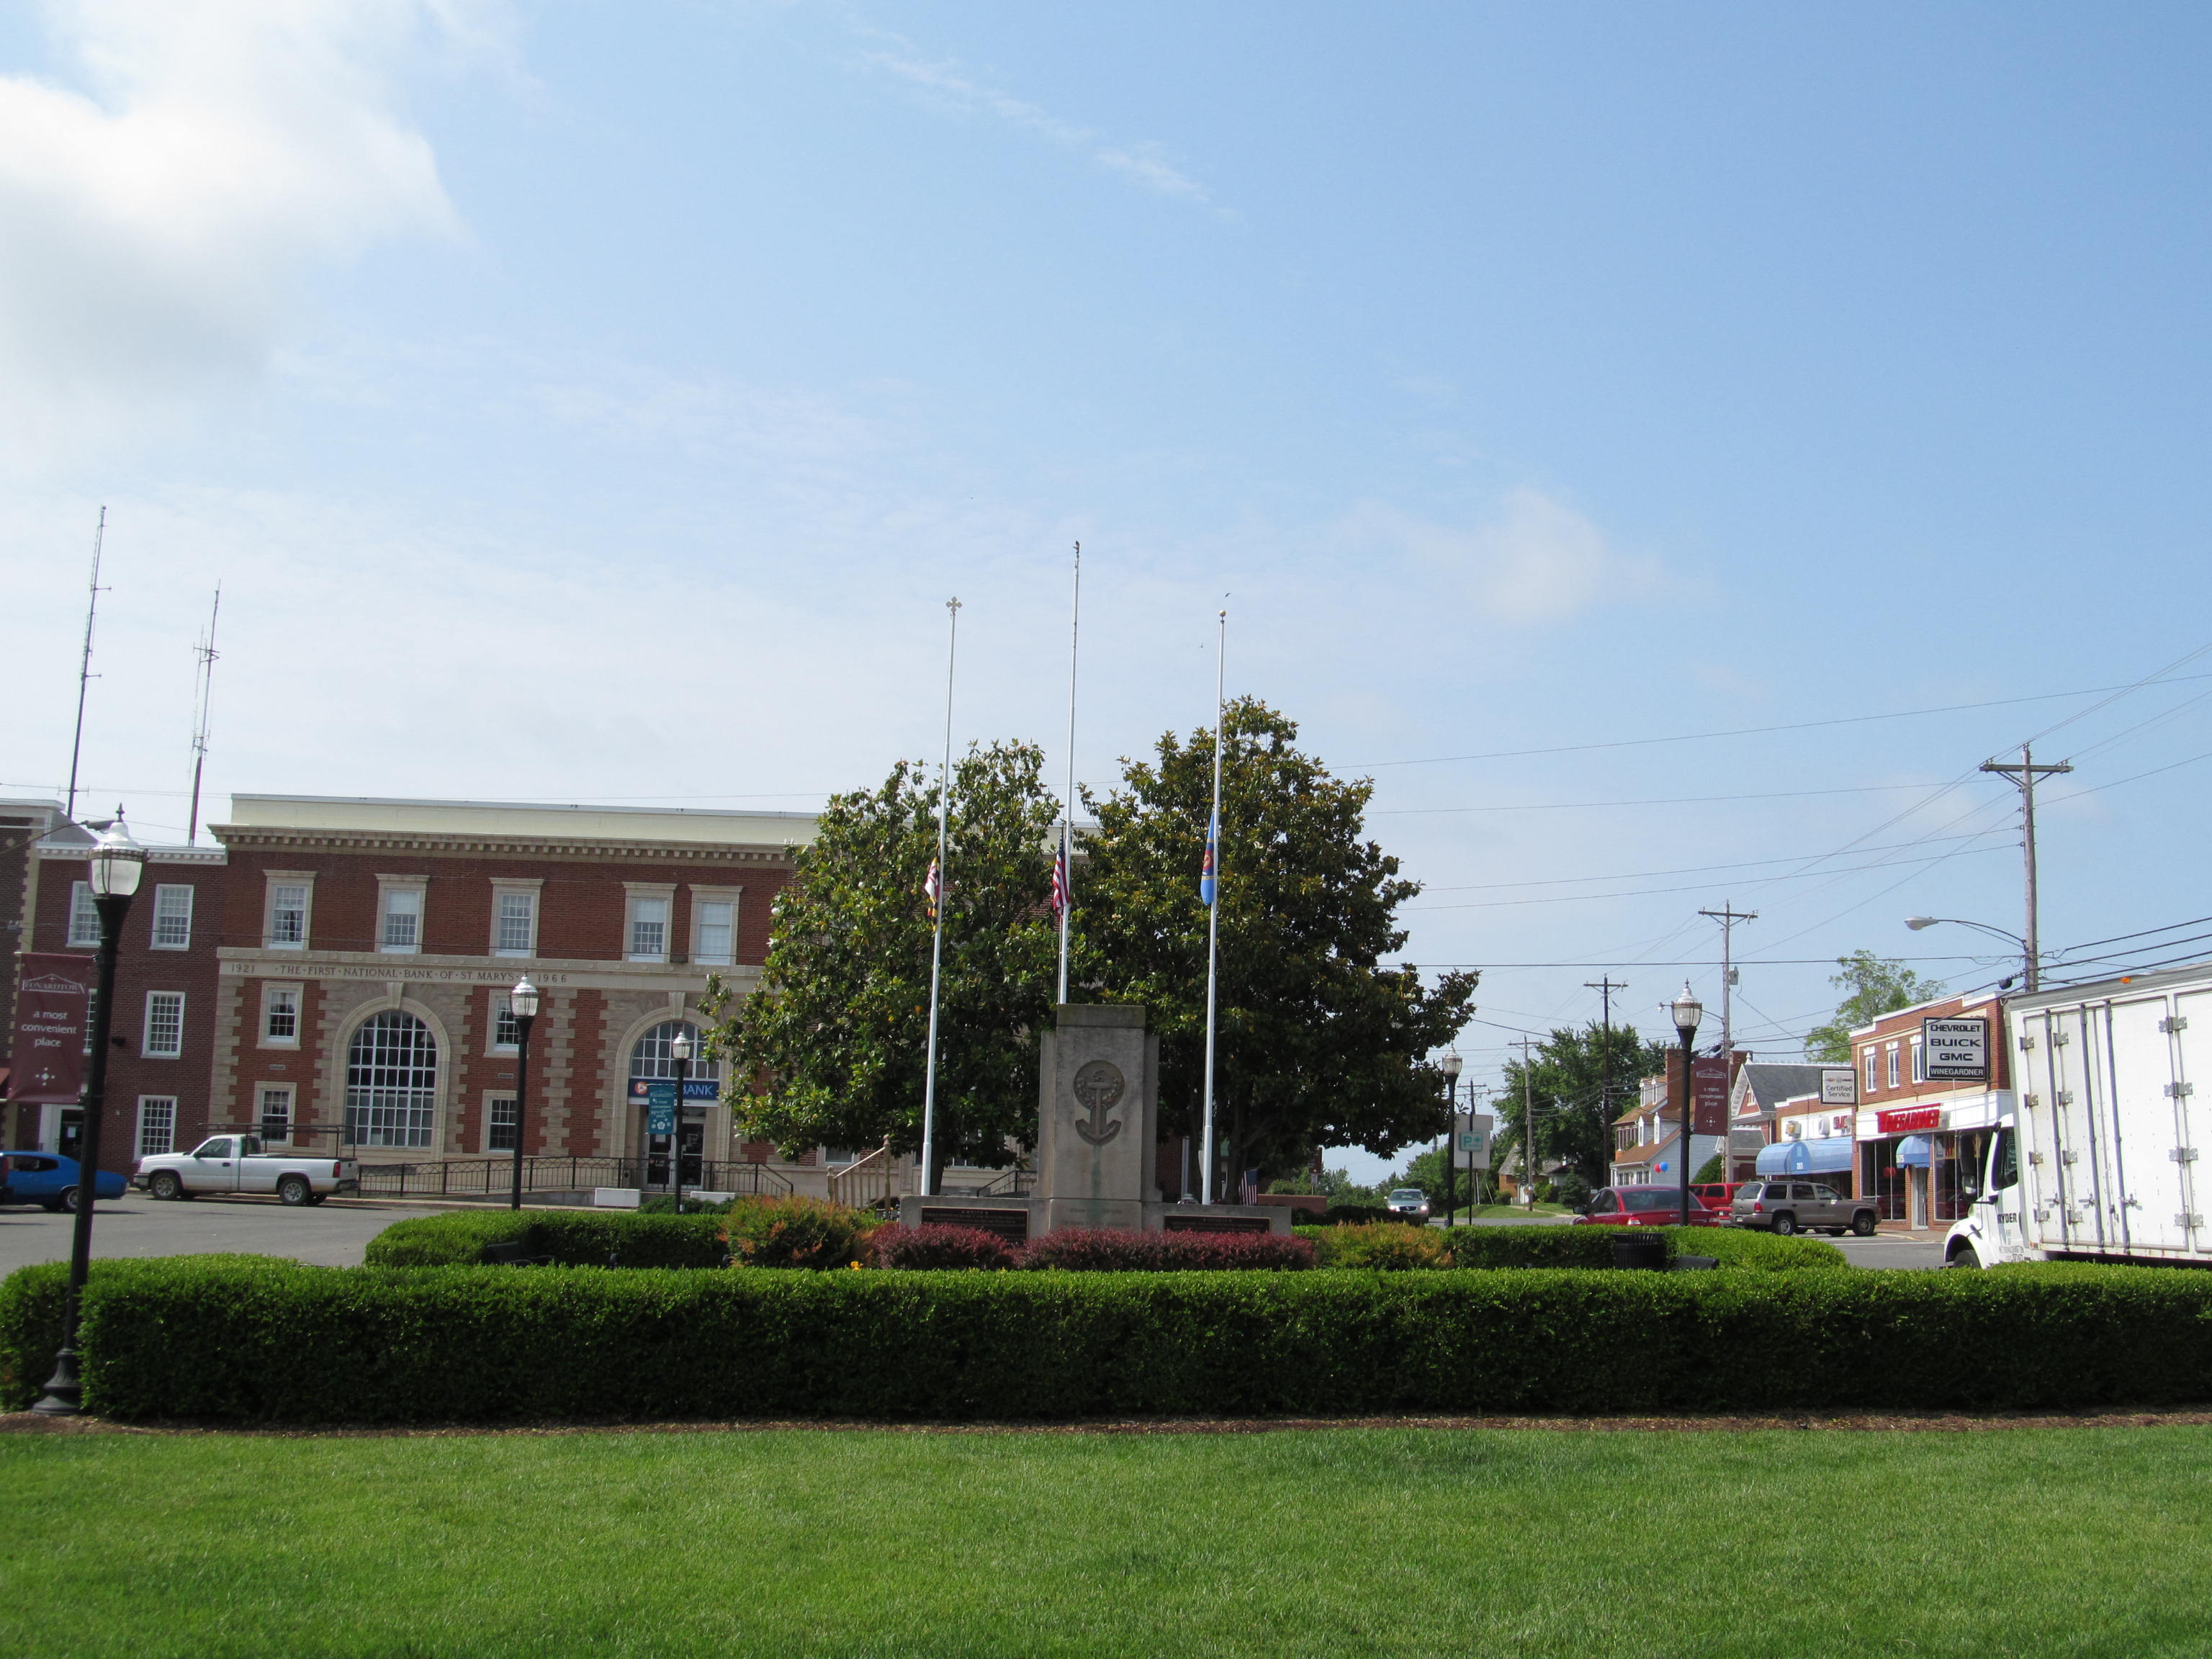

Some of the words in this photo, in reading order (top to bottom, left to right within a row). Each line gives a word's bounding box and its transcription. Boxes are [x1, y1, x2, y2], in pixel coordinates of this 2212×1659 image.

[281, 965, 301, 974] THE
[308, 966, 336, 976] FIRST
[343, 968, 398, 978] NATIONAL
[404, 969, 432, 979] BANK
[440, 971, 453, 979] OF
[461, 971, 475, 980] ST.
[538, 974, 567, 983] 1966
[42, 1011, 68, 1020] most
[22, 1024, 76, 1034] convenient
[35, 1037, 61, 1047] place
[1930, 1038, 1982, 1048] BUICK
[1939, 1053, 1974, 1061] GMC
[1833, 1115, 1848, 1130] GMC
[1463, 1136, 1473, 1147] P
[1997, 1213, 2018, 1223] RYDER
